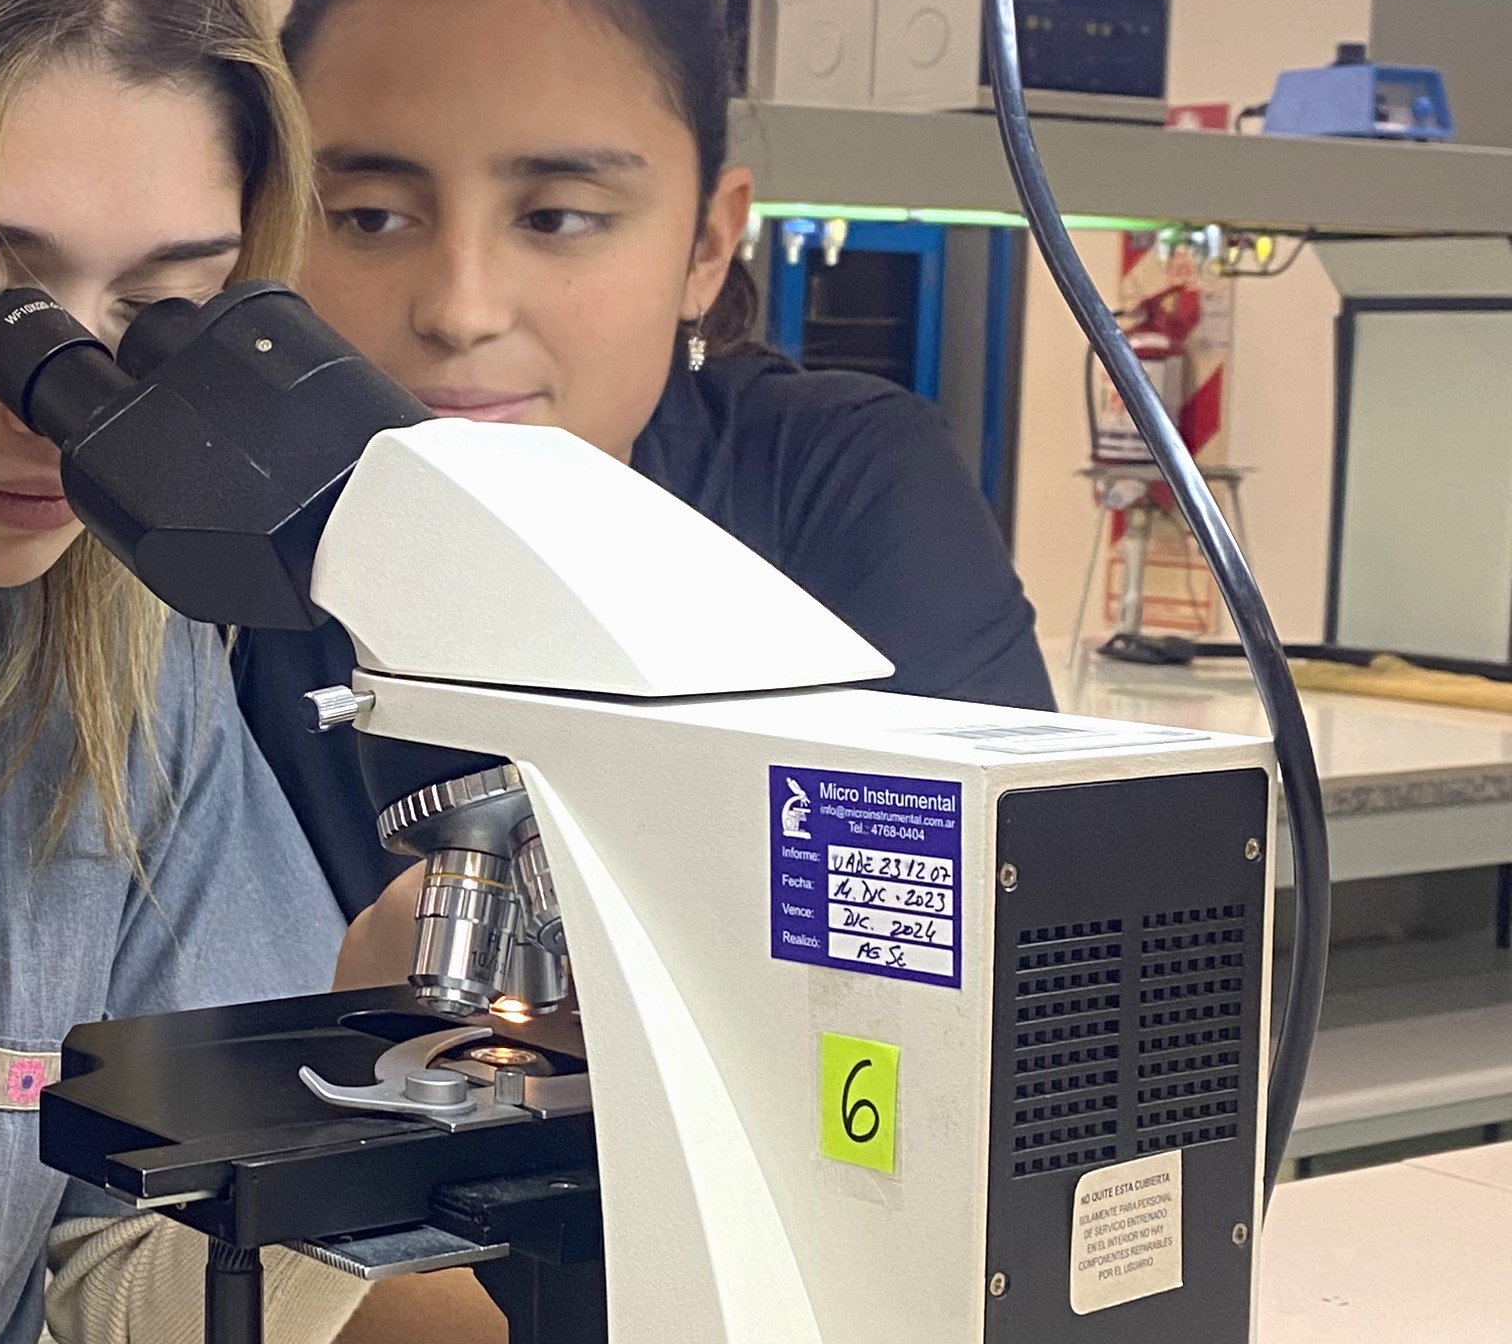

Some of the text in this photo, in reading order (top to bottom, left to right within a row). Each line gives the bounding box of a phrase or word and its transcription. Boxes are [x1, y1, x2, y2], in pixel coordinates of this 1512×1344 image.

[820, 782, 956, 812] Micro Instrumental
[820, 804, 955, 828] info@microinstrumental.com.ar
[871, 823, 925, 841] 4768-0404
[782, 846, 821, 862] Informe:
[782, 874, 814, 889] Fecha:
[782, 903, 814, 918] Vence:
[782, 931, 821, 948] Realizó:
[890, 920, 936, 943] 2024
[842, 1059, 880, 1143] 6
[1080, 1172, 1170, 1206] NO QUITE ESTA CUBIERTA
[1079, 1193, 1173, 1226] SOLAMENTE PARA PERSONAL
[1084, 1208, 1168, 1240] DE SERVICIO ENTRENADO
[1087, 1224, 1164, 1253] EN EL INTERIOR NO HAY
[1078, 1237, 1173, 1271] COMPONENTES REPARABLES
[1098, 1257, 1153, 1281] POR EL USUARIO
